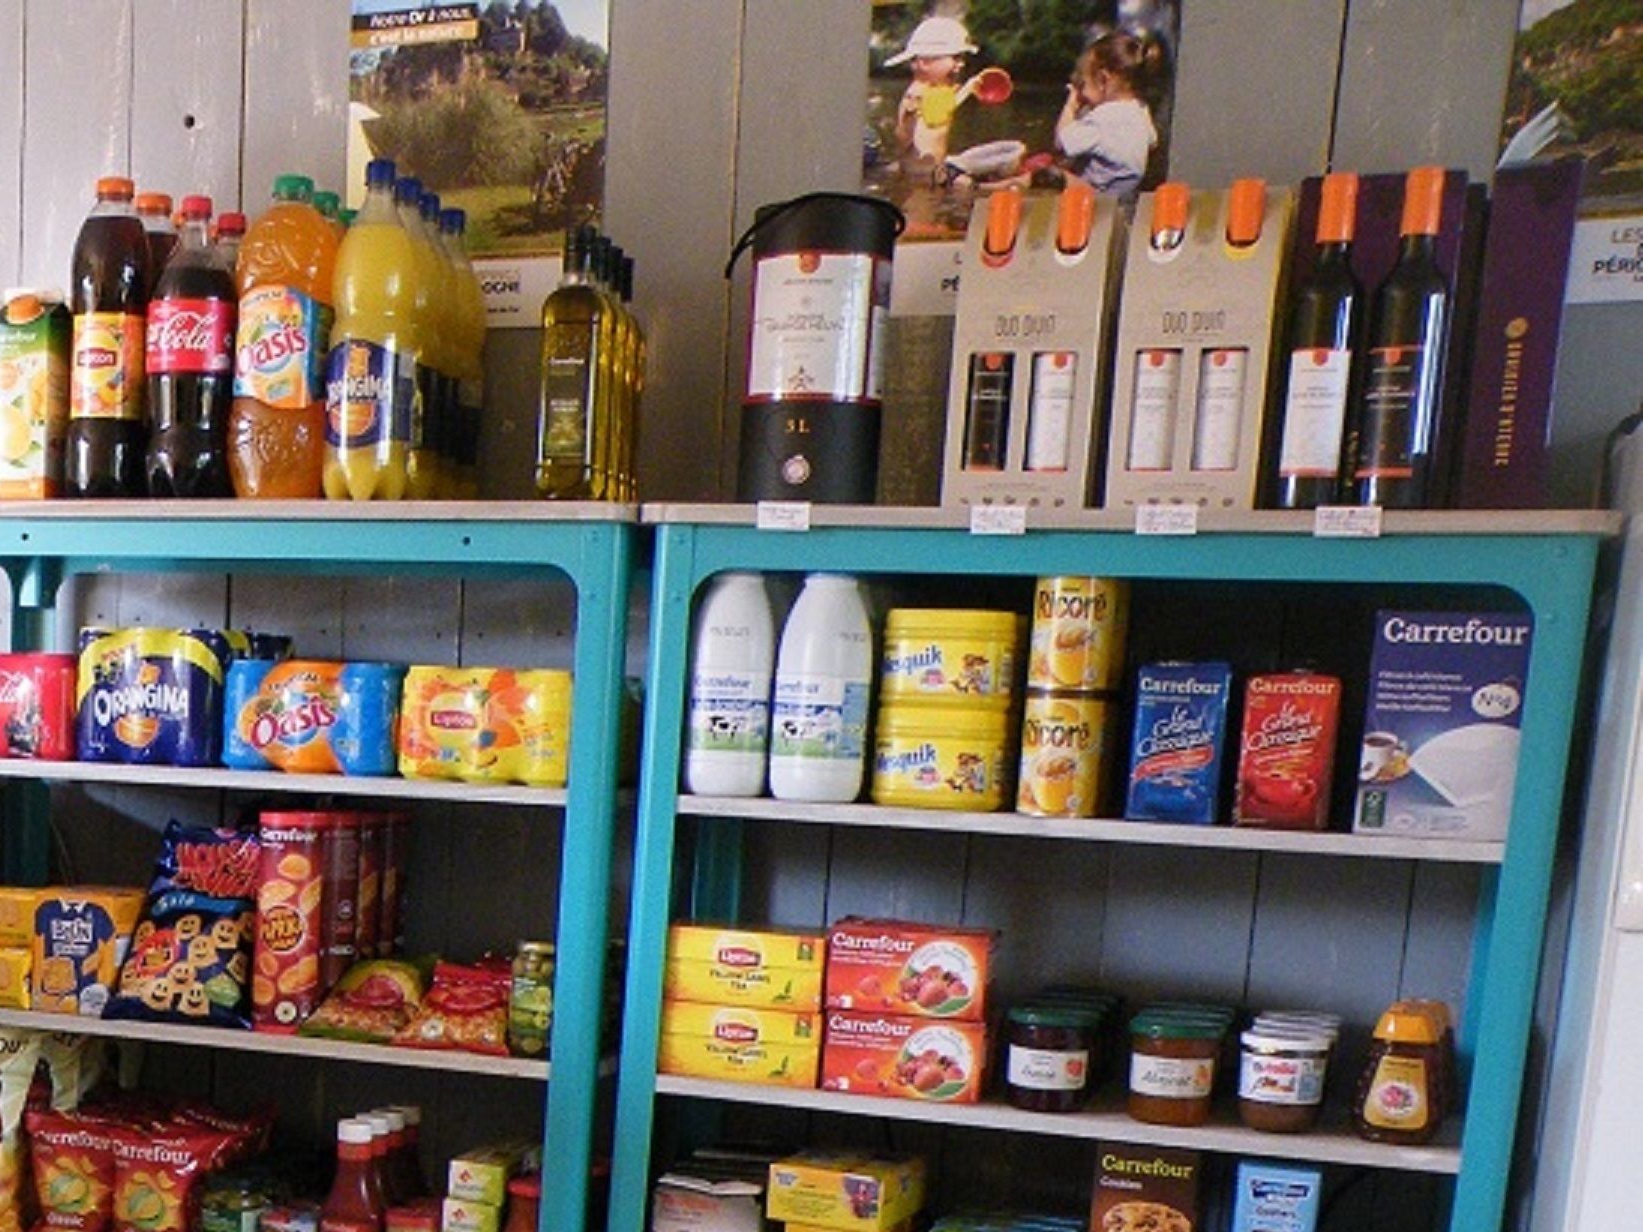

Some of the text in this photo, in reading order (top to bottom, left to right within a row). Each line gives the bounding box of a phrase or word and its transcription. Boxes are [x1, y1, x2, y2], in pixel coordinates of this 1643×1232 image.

[1037, 591, 1107, 621] Ricoré
[1383, 617, 1529, 645] Carrefour
[1140, 677, 1222, 694] Carrefour
[1250, 678, 1335, 695] Carrefour
[94, 683, 188, 727] ORANGINA
[252, 697, 337, 749] Oasis
[832, 932, 914, 953] Carrefour
[720, 949, 758, 964] Lipton
[717, 1024, 755, 1039] Lipton
[829, 1013, 911, 1037] Carrefour
[1101, 1154, 1194, 1179] Carrefour
